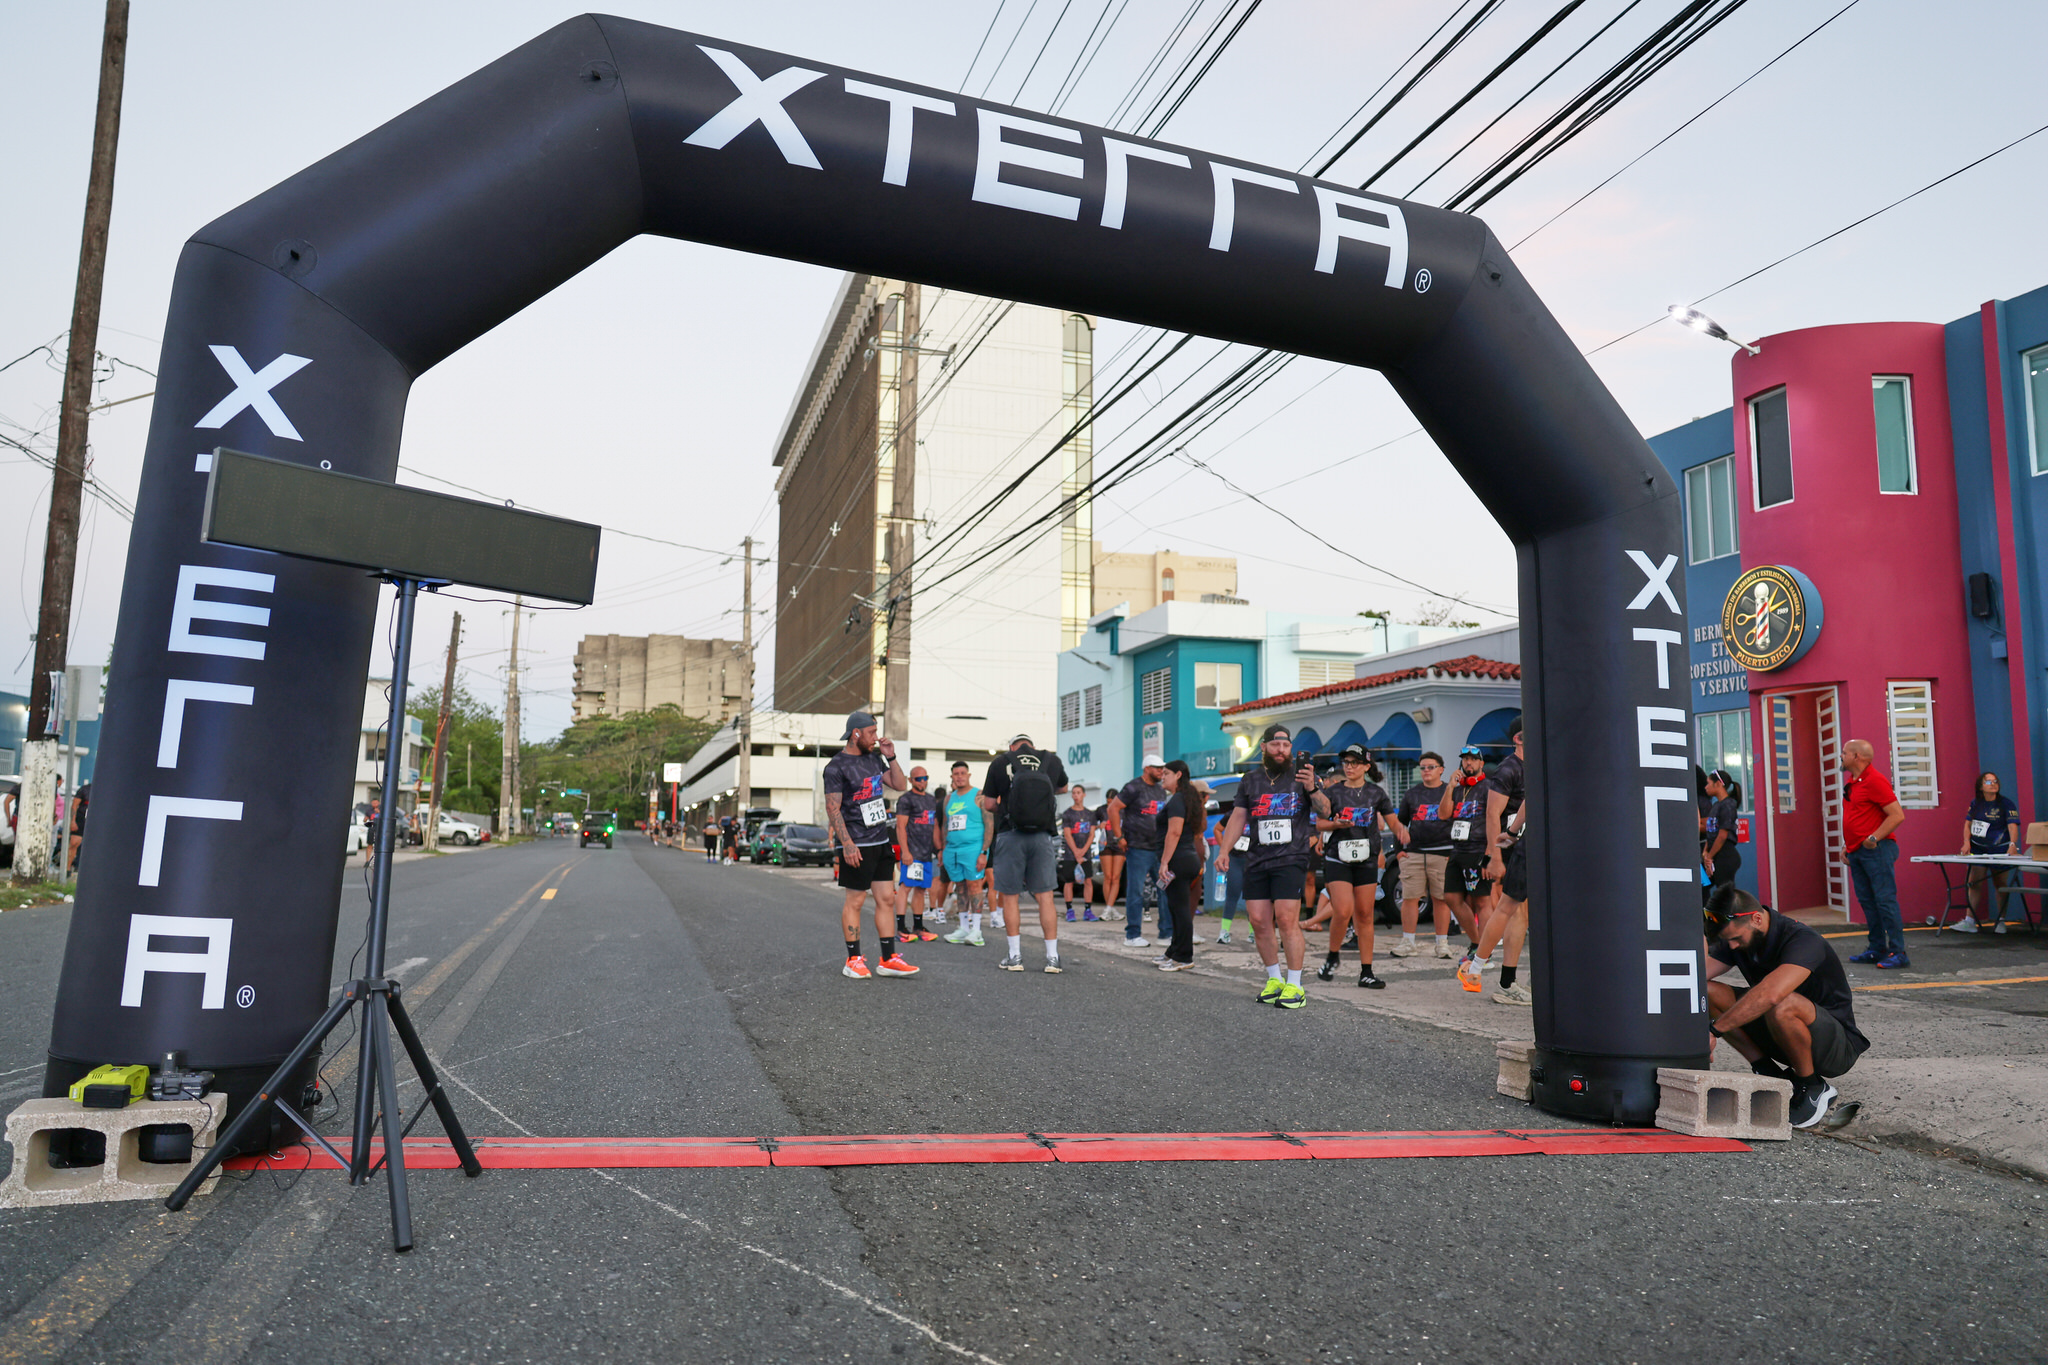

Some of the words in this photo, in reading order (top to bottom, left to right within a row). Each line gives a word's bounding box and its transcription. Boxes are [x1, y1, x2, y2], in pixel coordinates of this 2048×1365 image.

[1724, 602, 1733, 630] COLEGIO
[1729, 594, 1737, 603] DE
[1734, 573, 1757, 596] BARBEROS
[1760, 570, 1786, 583] ESTILISTAS
[1783, 579, 1792, 588] EN
[1736, 651, 1770, 667] PUERTO
[1771, 644, 1791, 664] RICO
[121, 345, 314, 1010] XERRA
[1700, 681, 1707, 696] Y
[1206, 756, 1216, 770] 25
[1258, 793, 1290, 809] 5K
[870, 809, 886, 822] 213
[1341, 807, 1369, 820] 5K
[1268, 830, 1281, 841] 10
[1351, 850, 1358, 858] 6
